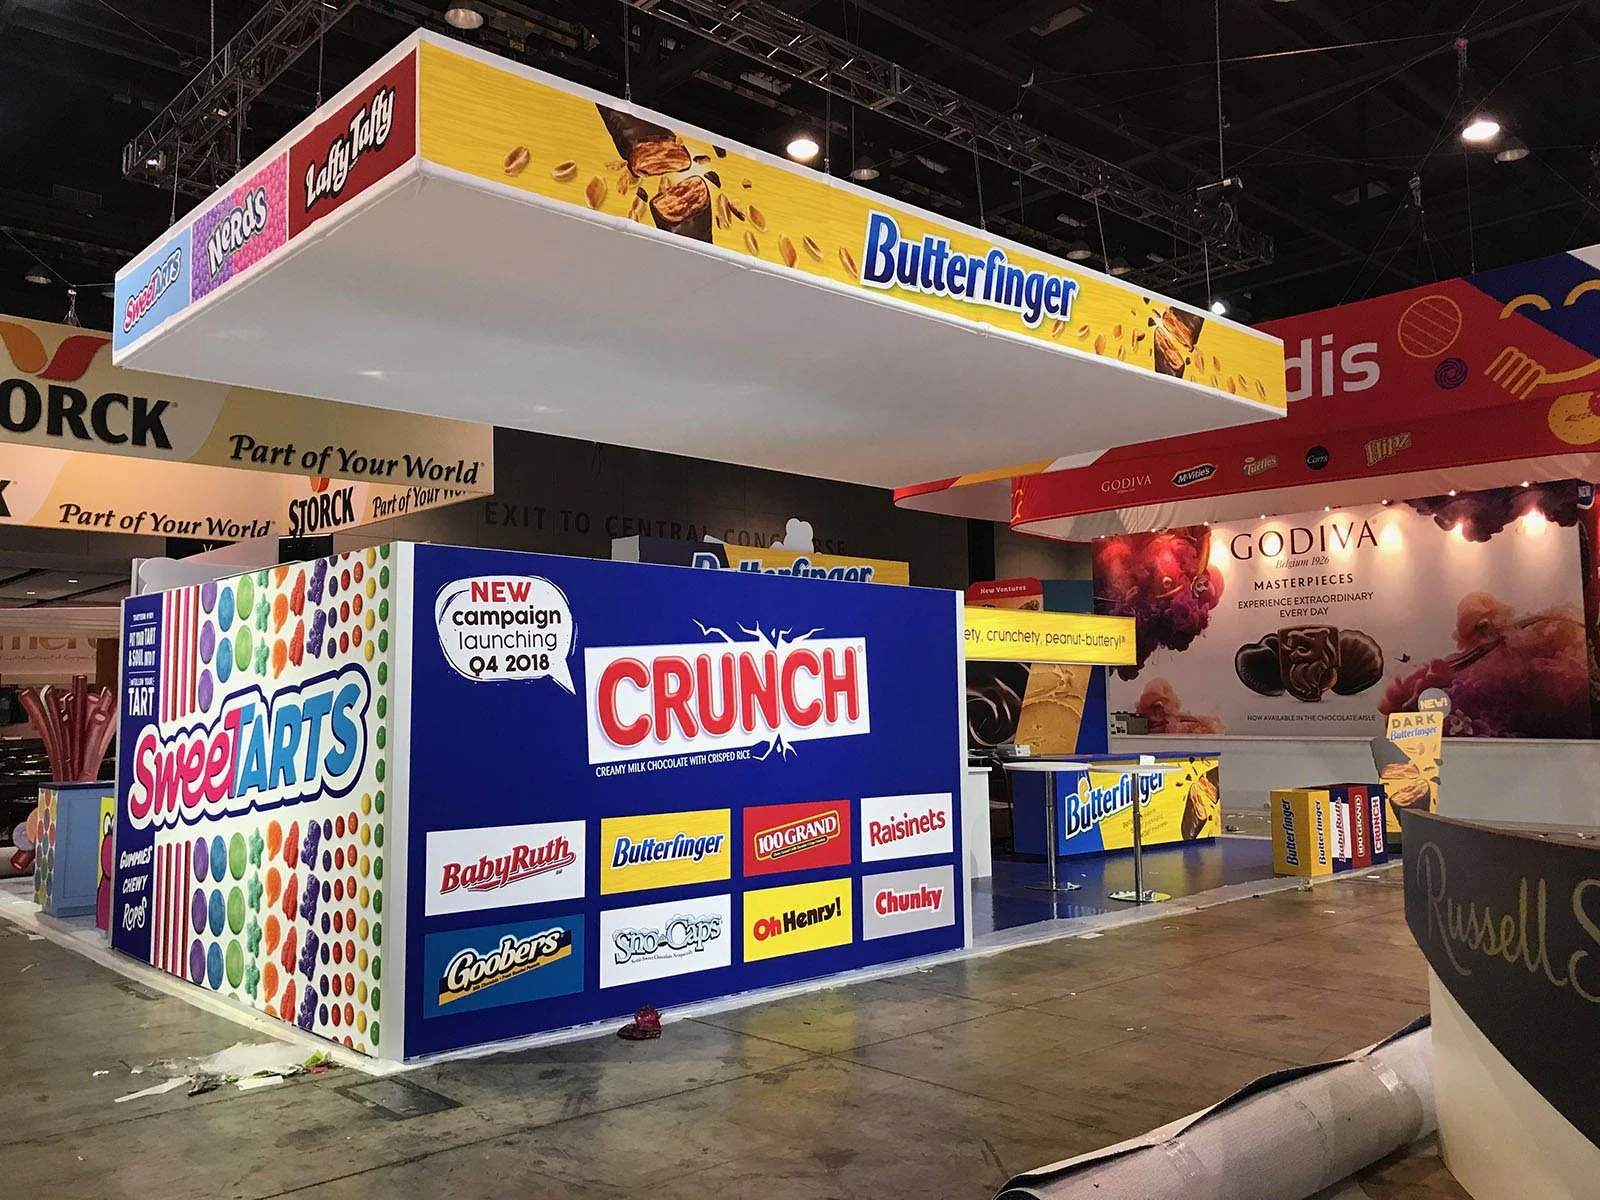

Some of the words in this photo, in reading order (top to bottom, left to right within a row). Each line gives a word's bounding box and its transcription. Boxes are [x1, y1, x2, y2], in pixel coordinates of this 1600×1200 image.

[305, 137, 350, 209] Laffy
[349, 86, 395, 161] Taffy
[862, 211, 1079, 327] Butterfinger
[230, 434, 296, 466] Part
[301, 446, 333, 474] of
[337, 446, 398, 476] Your
[403, 454, 479, 485] World
[1101, 474, 1152, 492] GODIVA
[288, 486, 354, 536] STORCK
[372, 496, 397, 518] Part
[399, 488, 412, 512] of
[485, 501, 546, 530] EXIT
[559, 510, 591, 535] TO
[59, 503, 115, 527] Part
[120, 512, 147, 533] of
[151, 512, 202, 535] Your
[206, 517, 270, 538] World
[1230, 520, 1378, 560] GODIVA
[1275, 558, 1309, 569] Belgium
[1311, 556, 1330, 565] 1926
[471, 581, 532, 603] NEW
[996, 585, 1027, 593] Ventures
[1254, 574, 1353, 591] MASTERPIECES
[1238, 598, 1292, 609] EXPERIENCE
[1294, 592, 1374, 605] EXTRAORDINARY
[1280, 608, 1307, 618] EVERY
[1310, 607, 1329, 616] DAY
[452, 605, 561, 629] campaign
[459, 630, 557, 651] launching
[986, 629, 1043, 646] crunchety,
[469, 655, 498, 677] Q4
[505, 654, 550, 672] 2018
[128, 686, 155, 716] TART
[597, 646, 860, 747] CRUNCH
[1390, 726, 1437, 741] Butterfinger
[1391, 714, 1436, 728] DARK
[595, 763, 626, 778] CREAMY
[628, 761, 646, 774] MILK
[647, 757, 689, 771] CHOCOLATE
[689, 754, 707, 766] WITH
[707, 751, 736, 764] CRISPED
[736, 749, 751, 760] RICE
[1065, 772, 1163, 837] Butterfiger
[758, 831, 783, 854] 100
[784, 816, 837, 846] GRAND
[869, 808, 946, 847] Raisinets
[1282, 798, 1299, 866] Butterfinger
[1315, 800, 1327, 865] Butterfinger
[1373, 799, 1382, 851] CRUNCH
[120, 845, 153, 870] GUMMIES
[611, 832, 724, 869] Butterfinger
[122, 874, 148, 894] CHEWY
[874, 886, 944, 916] Chunky
[1416, 841, 1568, 986] Russell
[753, 915, 782, 942] Oh
[783, 896, 842, 933] Henry!
[446, 930, 561, 991] Goobers
